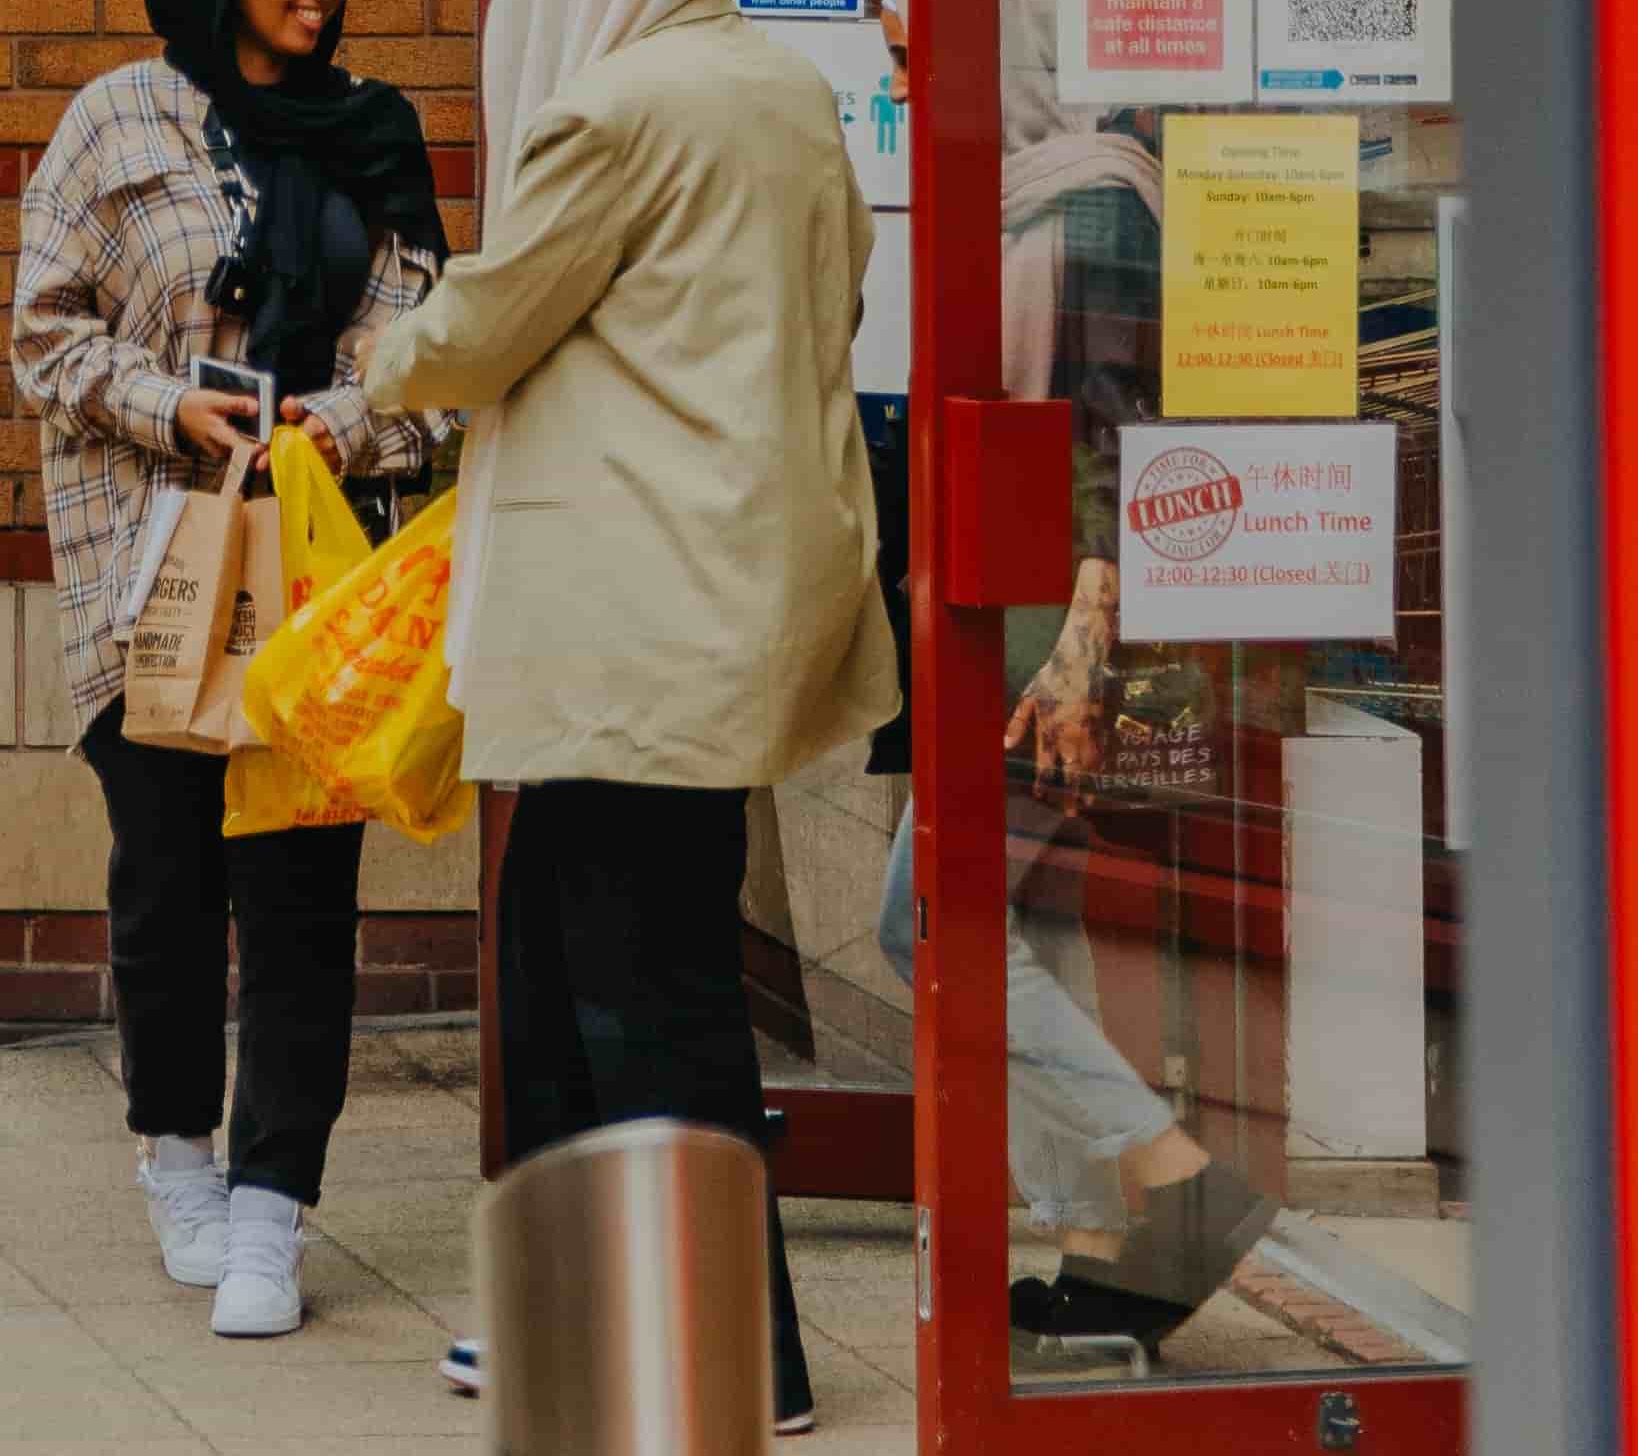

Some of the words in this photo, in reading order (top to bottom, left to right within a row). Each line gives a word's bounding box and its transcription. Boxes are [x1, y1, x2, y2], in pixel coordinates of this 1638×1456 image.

[1093, 14, 1132, 33] safe
[1137, 14, 1217, 33] distance
[1127, 37, 1150, 56] all
[1155, 37, 1207, 56] times
[1243, 462, 1353, 494] 午休时间
[1137, 479, 1235, 530] LUNCH
[1243, 510, 1309, 533] Lunch
[1318, 511, 1373, 533] Time
[1144, 564, 1248, 585] 12:00-12:30
[1253, 563, 1318, 586] (Closed
[1168, 746, 1212, 766] DES
